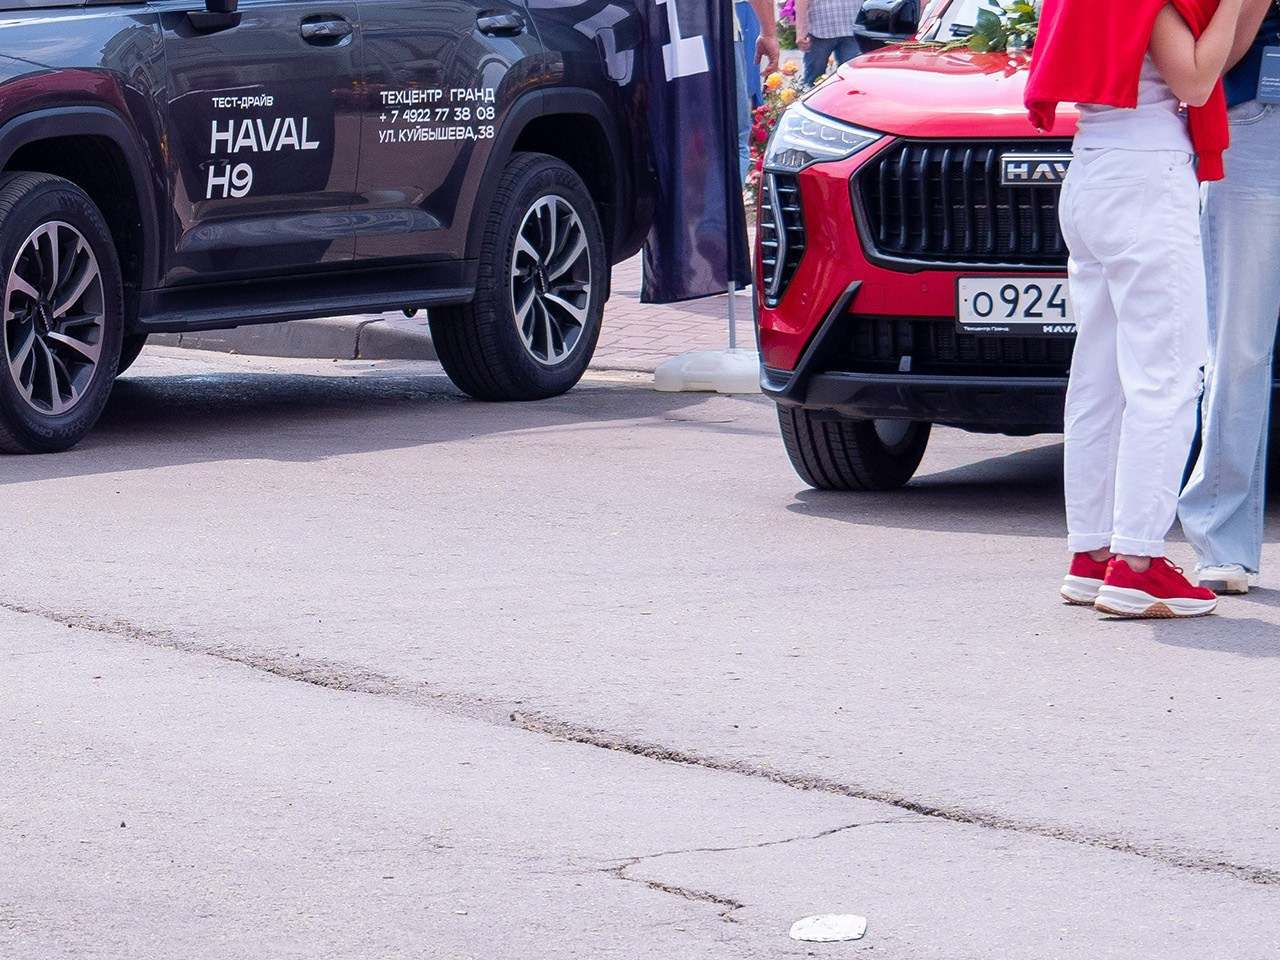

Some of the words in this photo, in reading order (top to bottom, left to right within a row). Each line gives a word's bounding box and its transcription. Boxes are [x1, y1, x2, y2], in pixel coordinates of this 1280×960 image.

[212, 94, 274, 109] ТЕСТ-ДРАЙВ
[380, 89, 443, 106] ТЕХЦЕНТР
[450, 88, 495, 103] ГРАНД
[402, 108, 431, 123] 4922
[435, 108, 449, 121] 77
[454, 107, 471, 121] 38
[476, 106, 495, 120] 08
[210, 117, 320, 154] HAVAL
[379, 129, 396, 143] УЛ.
[1006, 163, 1069, 180] HAV
[206, 162, 253, 199] H9
[972, 284, 1067, 318] О924
